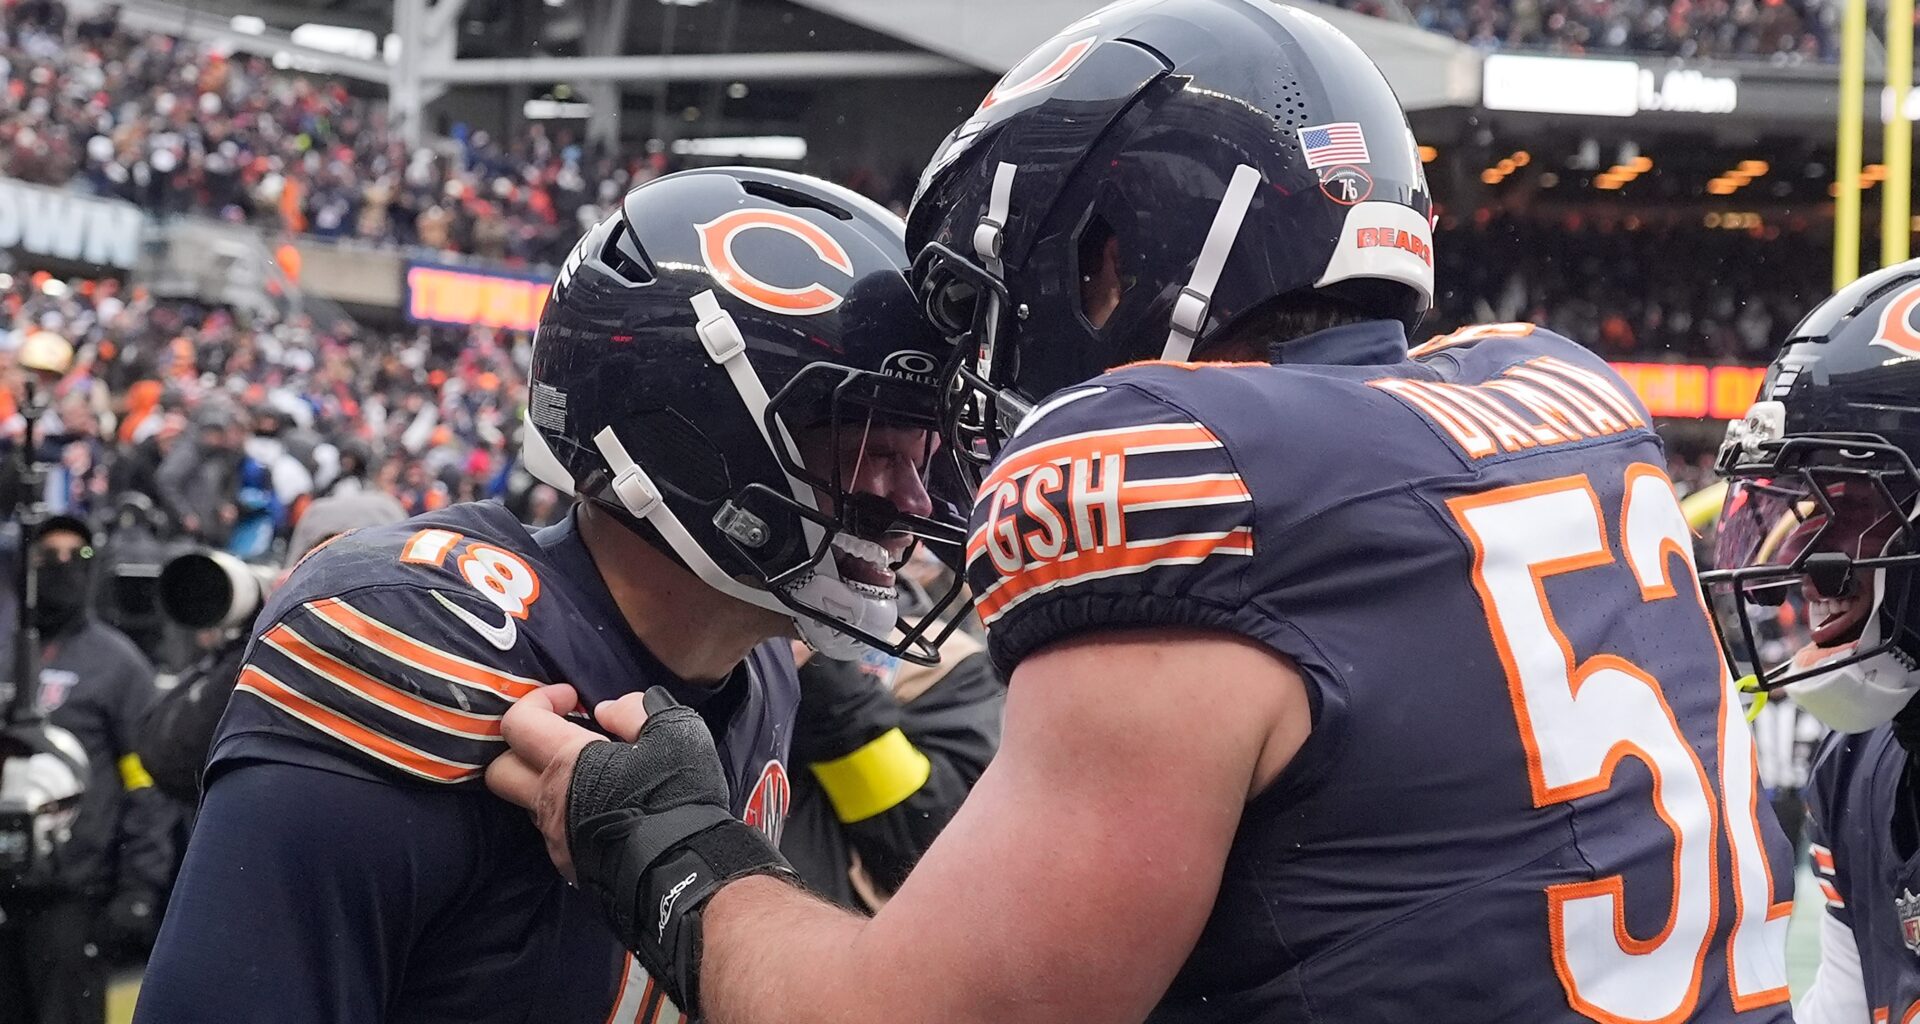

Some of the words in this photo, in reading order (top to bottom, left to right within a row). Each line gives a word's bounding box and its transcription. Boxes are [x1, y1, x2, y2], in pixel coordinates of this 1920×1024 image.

[1338, 178, 1358, 201] 76
[884, 368, 940, 387] OAKLEY
[1364, 356, 1647, 460] DALMAN
[986, 449, 1127, 577] GSH
[399, 528, 541, 620] 18
[1445, 461, 1794, 1023] 52
